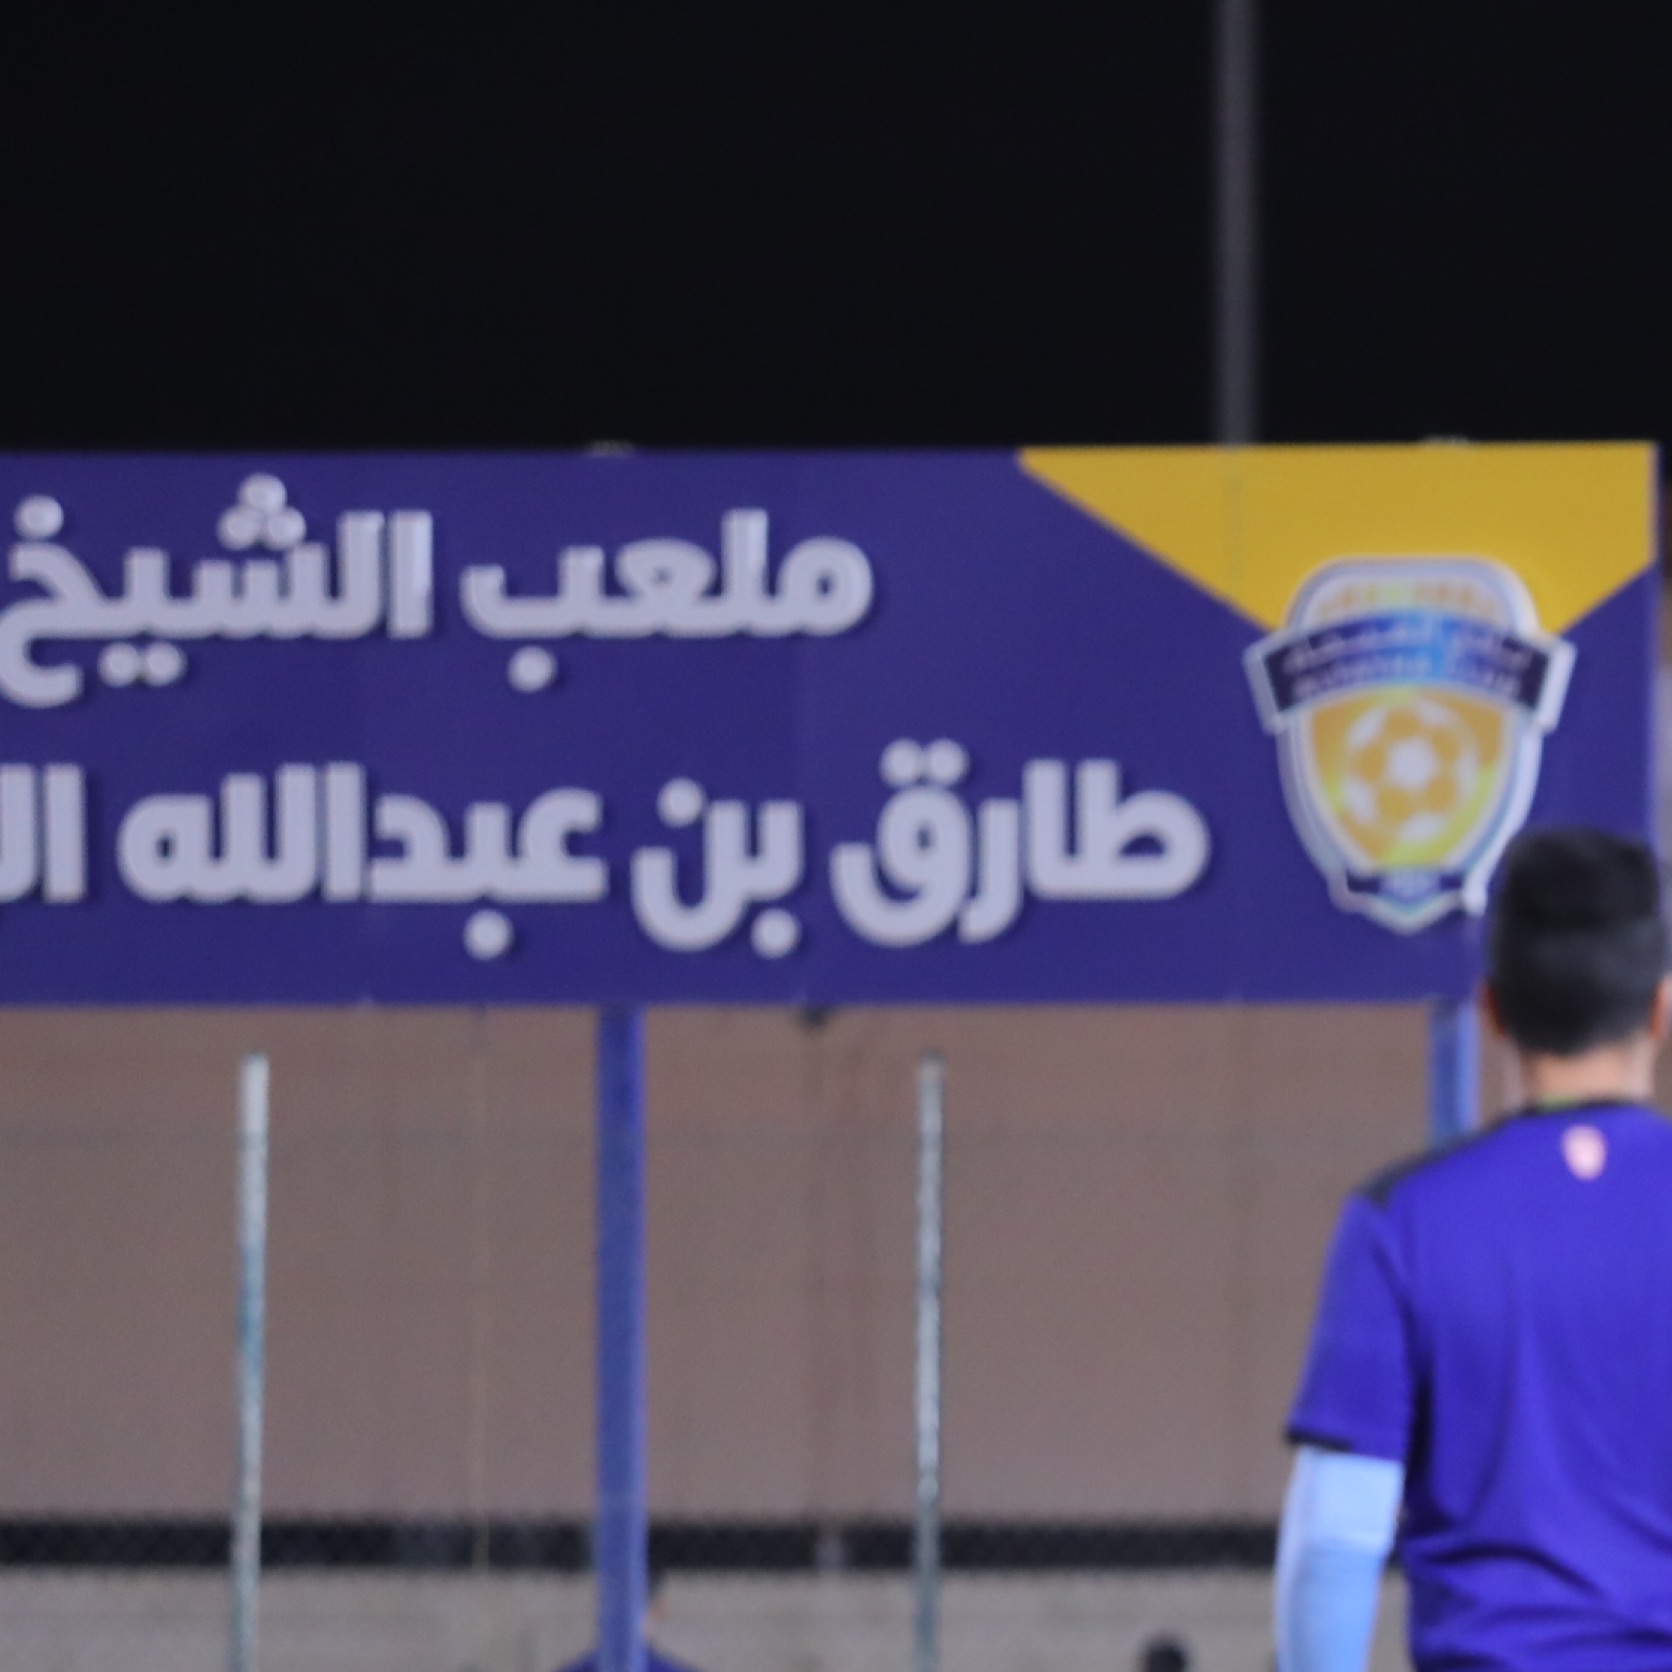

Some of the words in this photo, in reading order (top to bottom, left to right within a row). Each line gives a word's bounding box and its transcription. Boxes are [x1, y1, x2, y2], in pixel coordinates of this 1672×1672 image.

[0, 477, 432, 705] الشيخ
[463, 510, 872, 689] ملعب
[120, 764, 605, 956] عبدالله
[634, 781, 800, 954] بن
[831, 741, 1206, 944] طارق
